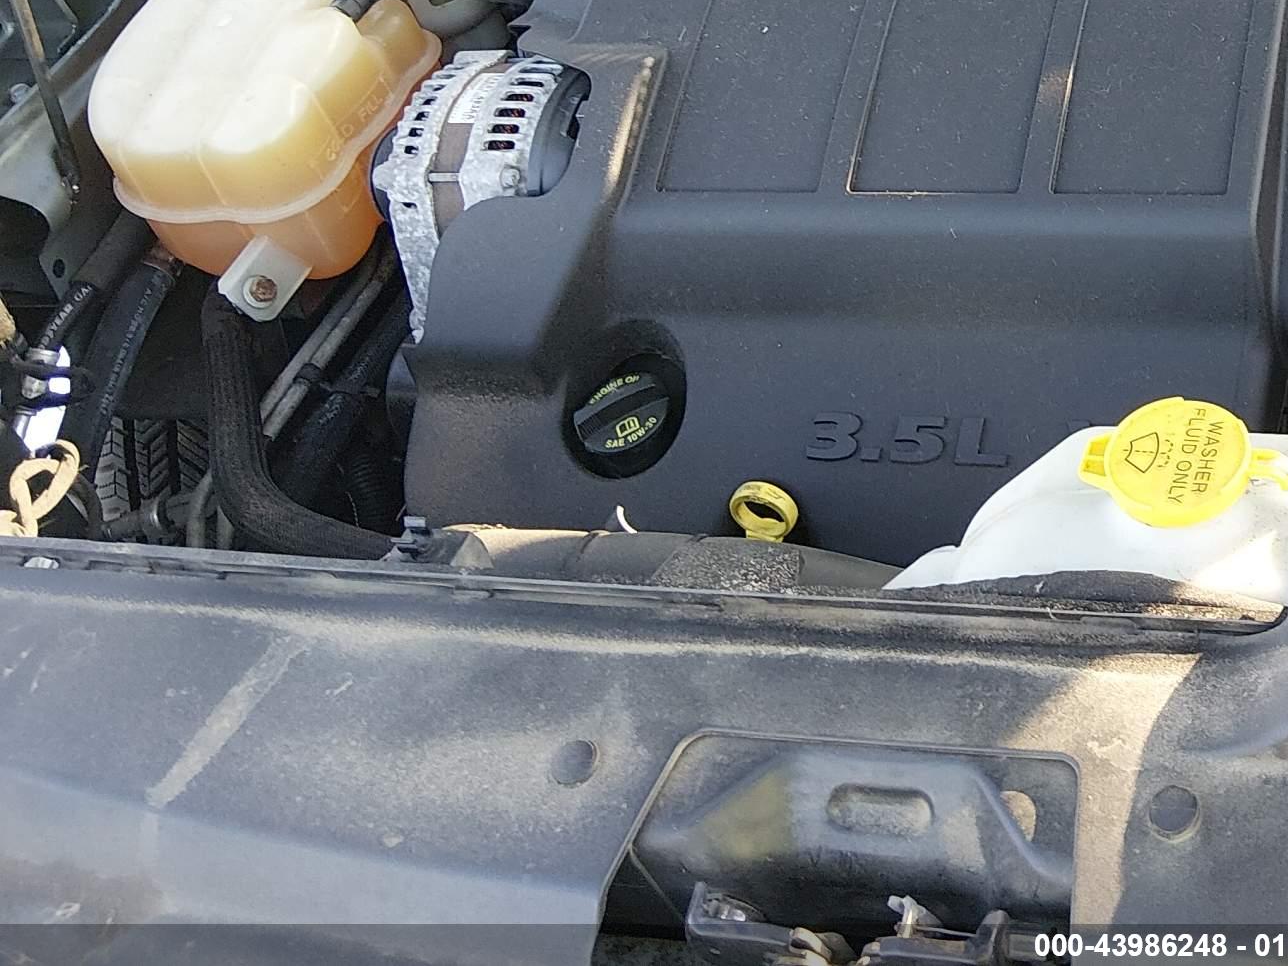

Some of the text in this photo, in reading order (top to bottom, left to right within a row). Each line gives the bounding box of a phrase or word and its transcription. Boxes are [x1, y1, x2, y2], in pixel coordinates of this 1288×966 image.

[604, 416, 658, 449] SAE 10W-30
[806, 411, 1010, 468] 3.5L
[1167, 408, 1207, 504] FLUID ONLY
[1191, 421, 1224, 494] WASHER
